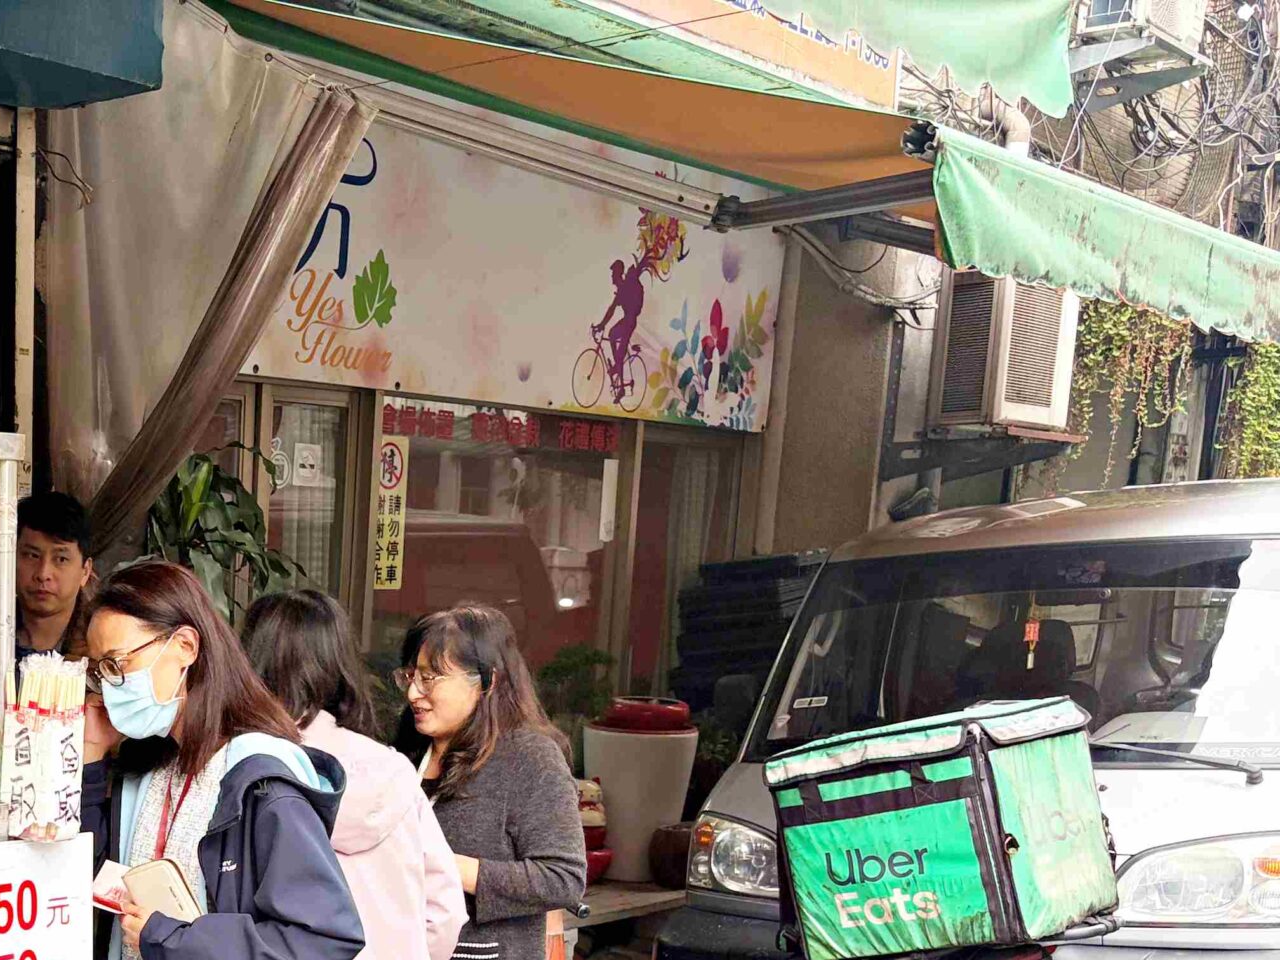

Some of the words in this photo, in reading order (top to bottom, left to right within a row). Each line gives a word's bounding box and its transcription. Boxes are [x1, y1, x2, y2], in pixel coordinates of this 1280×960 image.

[286, 268, 345, 333] Yes
[385, 494, 402, 585] 請勿停車
[825, 847, 928, 886] Uber
[834, 887, 942, 930] Eats
